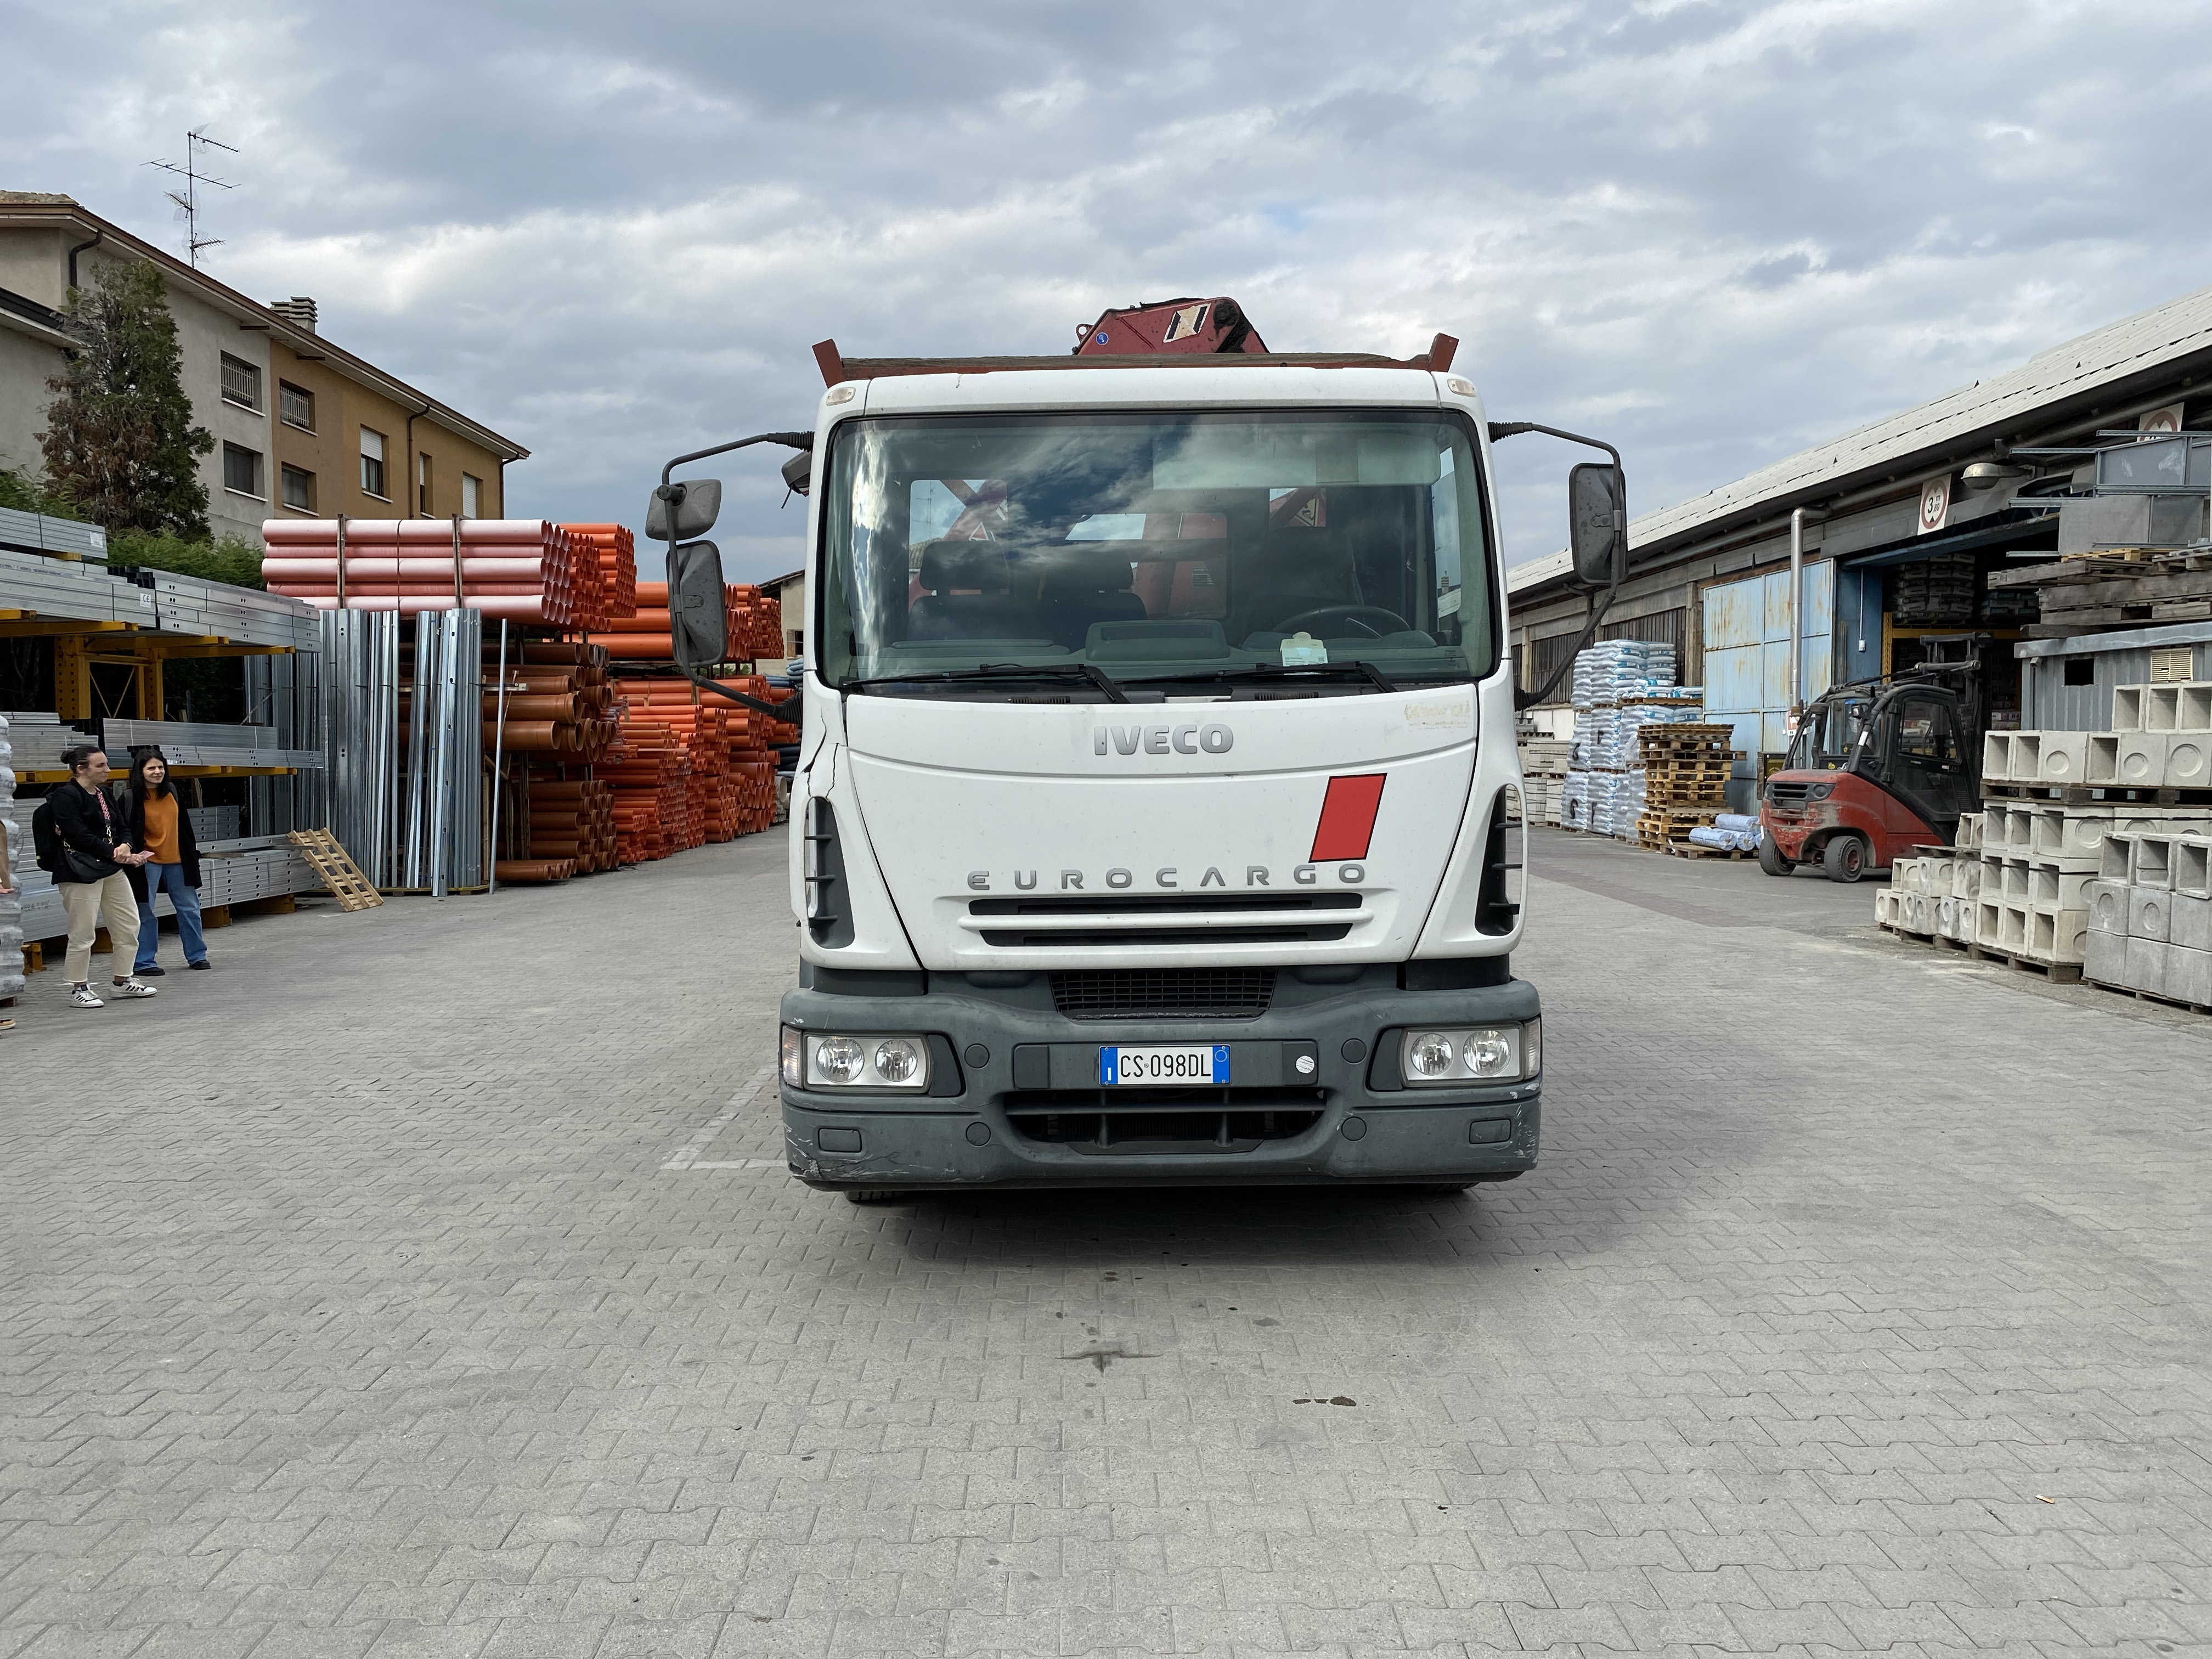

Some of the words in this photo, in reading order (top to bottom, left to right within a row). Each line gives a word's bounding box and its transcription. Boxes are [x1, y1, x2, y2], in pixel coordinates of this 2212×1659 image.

[1094, 723, 1234, 755] IVECO
[967, 863, 1366, 890] EUROCARGO
[1120, 1054, 1144, 1077] CS
[1150, 1054, 1211, 1077] 098DL
